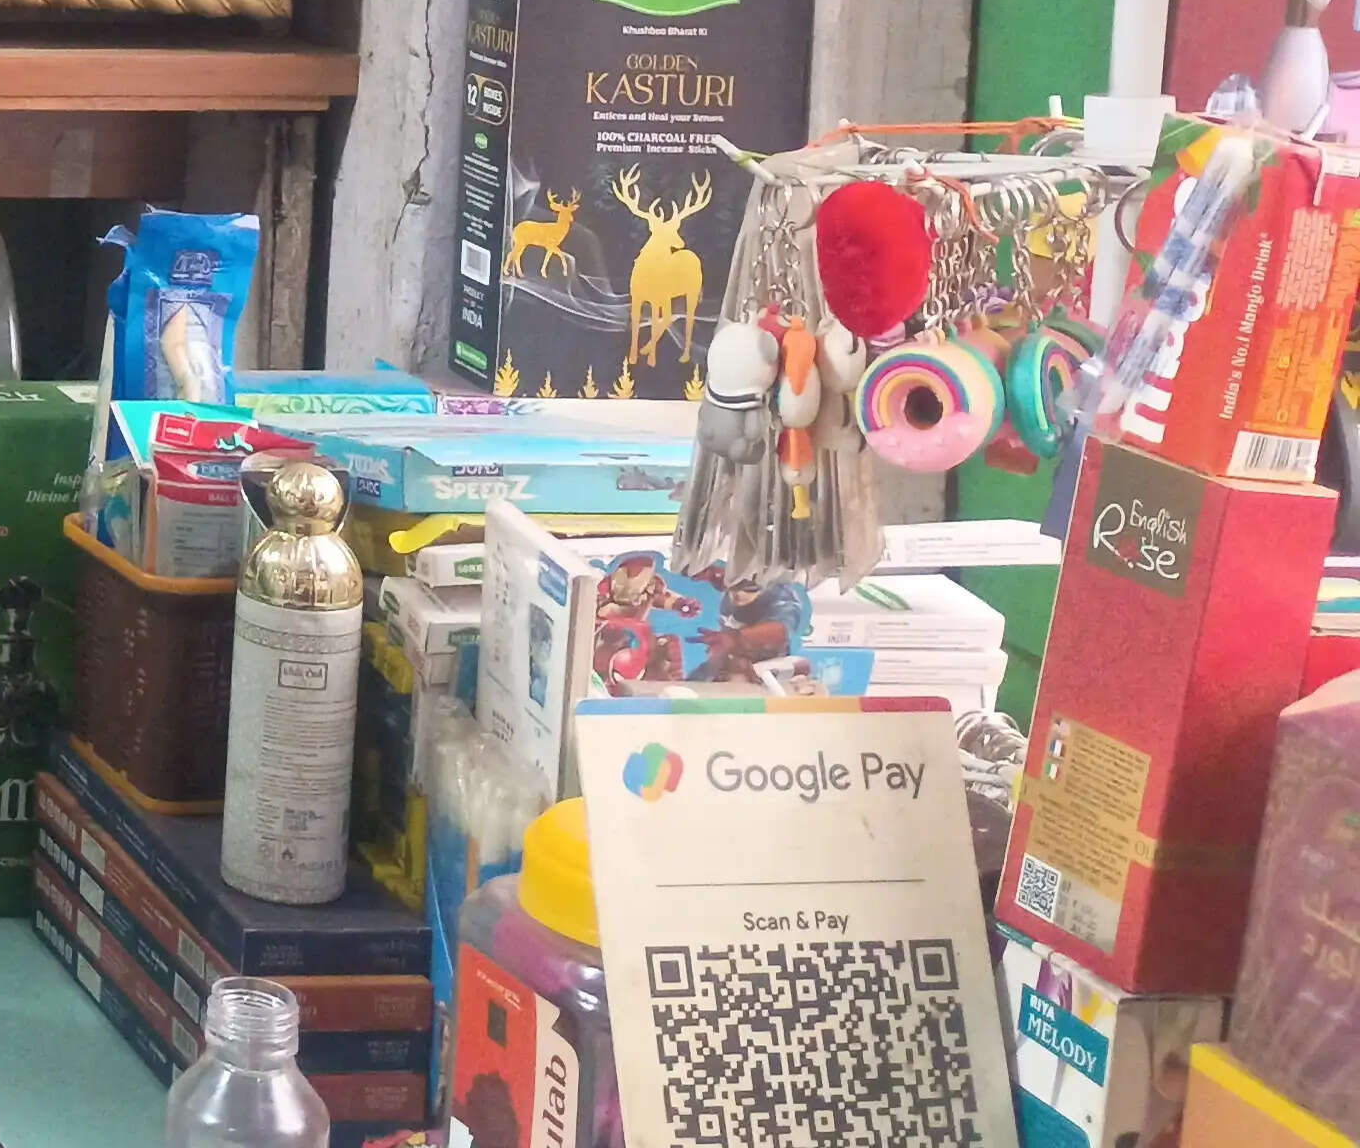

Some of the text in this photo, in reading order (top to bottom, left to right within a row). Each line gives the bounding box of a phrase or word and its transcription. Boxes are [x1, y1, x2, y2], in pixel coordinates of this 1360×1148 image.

[667, 26, 698, 37] Bharat
[626, 54, 698, 71] GOLDEN
[586, 71, 735, 107] KASTURI
[593, 111, 628, 122] Entices
[628, 112, 647, 122] and
[648, 112, 669, 122] Heal
[670, 114, 691, 125] your
[596, 131, 626, 143] 100%
[627, 132, 688, 144] CHARCOAL
[596, 143, 718, 155] Premium Incense Sticks
[462, 307, 483, 330] INDIA
[1239, 283, 1265, 335] Mango
[25, 490, 72, 503] Divine
[1129, 498, 1187, 546] English
[706, 750, 926, 803] Google Pay
[742, 910, 850, 935] Scan & Pay
[1029, 993, 1056, 1022] RIYA
[1026, 1012, 1097, 1073] MELODY
